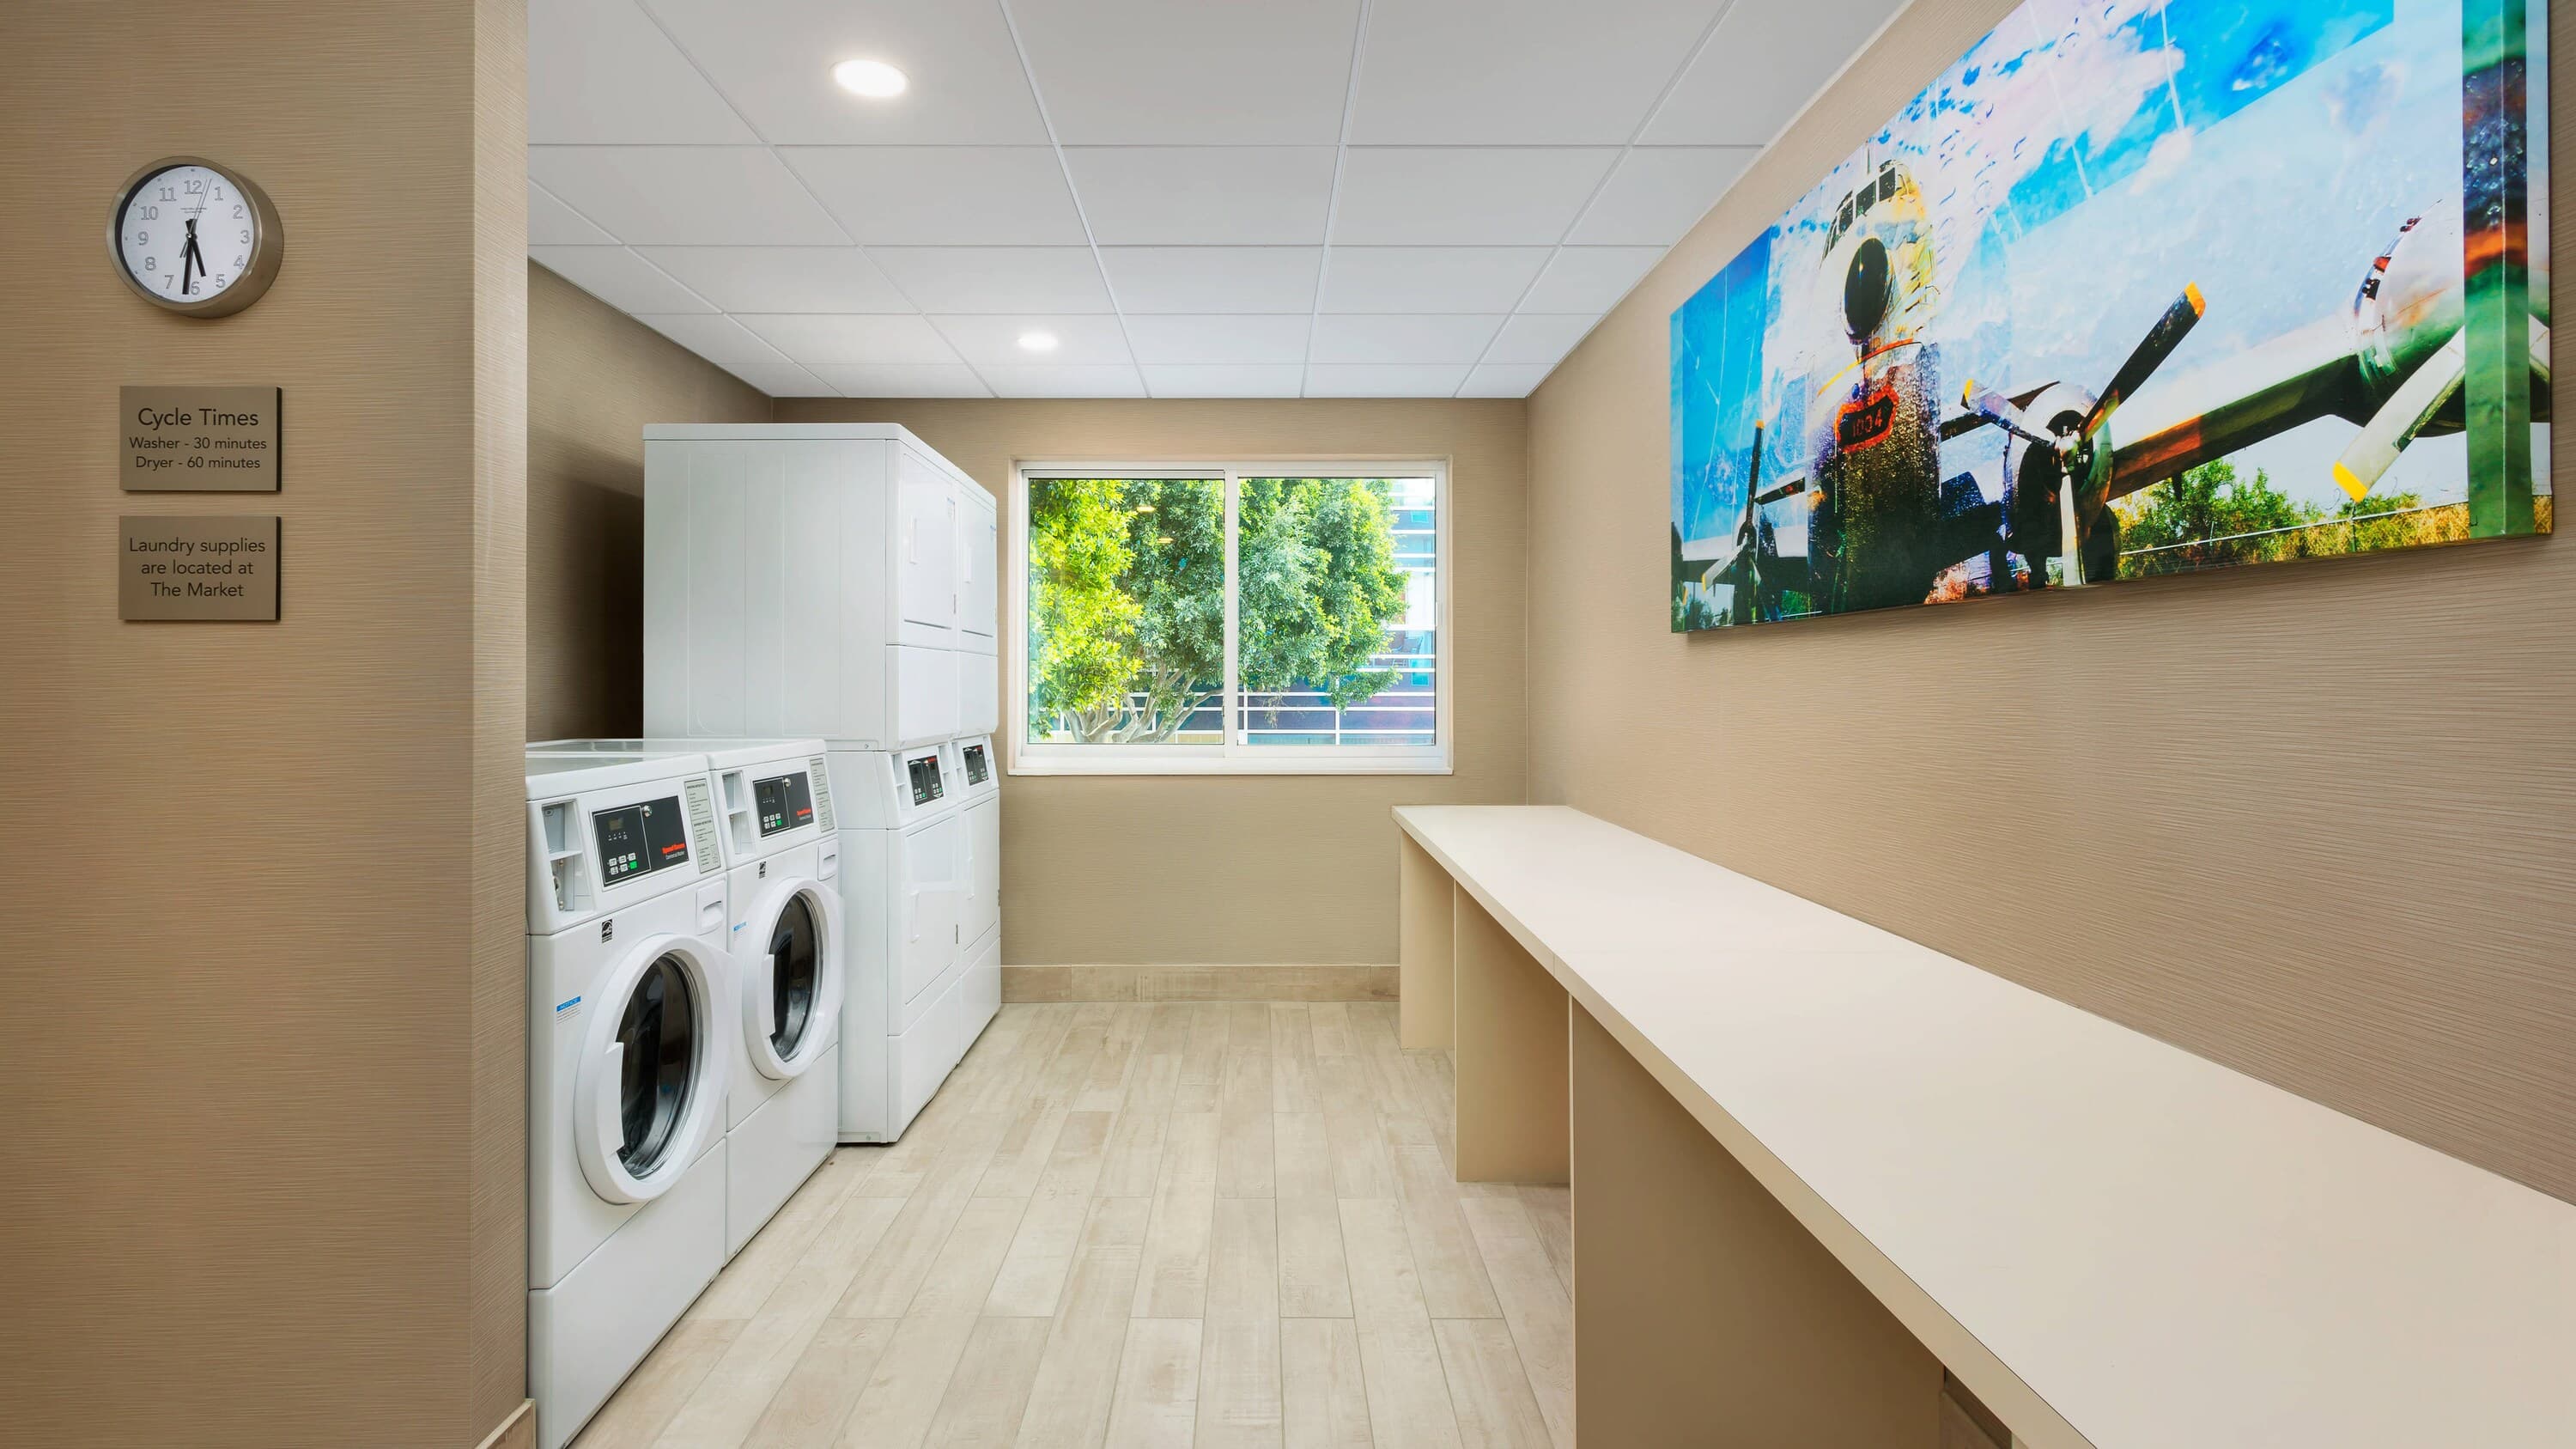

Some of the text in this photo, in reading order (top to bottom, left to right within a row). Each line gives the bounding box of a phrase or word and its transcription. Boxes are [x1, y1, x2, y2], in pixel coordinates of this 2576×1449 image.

[159, 187, 177, 202] 11
[184, 180, 203, 194] 12
[215, 186, 223, 201] 1
[140, 206, 158, 220] 10
[233, 204, 243, 219] 2
[138, 231, 149, 246] 9
[240, 229, 250, 244] 3
[144, 257, 156, 271] 8
[234, 255, 245, 270] 4
[165, 275, 174, 289] 7
[190, 282, 200, 295] 6
[216, 274, 226, 289] 5
[138, 407, 258, 430] Cycle Times
[129, 436, 180, 449] Washer
[194, 437, 210, 449] 30
[215, 437, 267, 449] minutes
[137, 456, 174, 472] Dryer
[187, 456, 204, 468] 60
[209, 456, 261, 468] minutes
[130, 537, 265, 557] Laundry supplies
[141, 559, 253, 575] are located at
[150, 581, 245, 597] The Market
